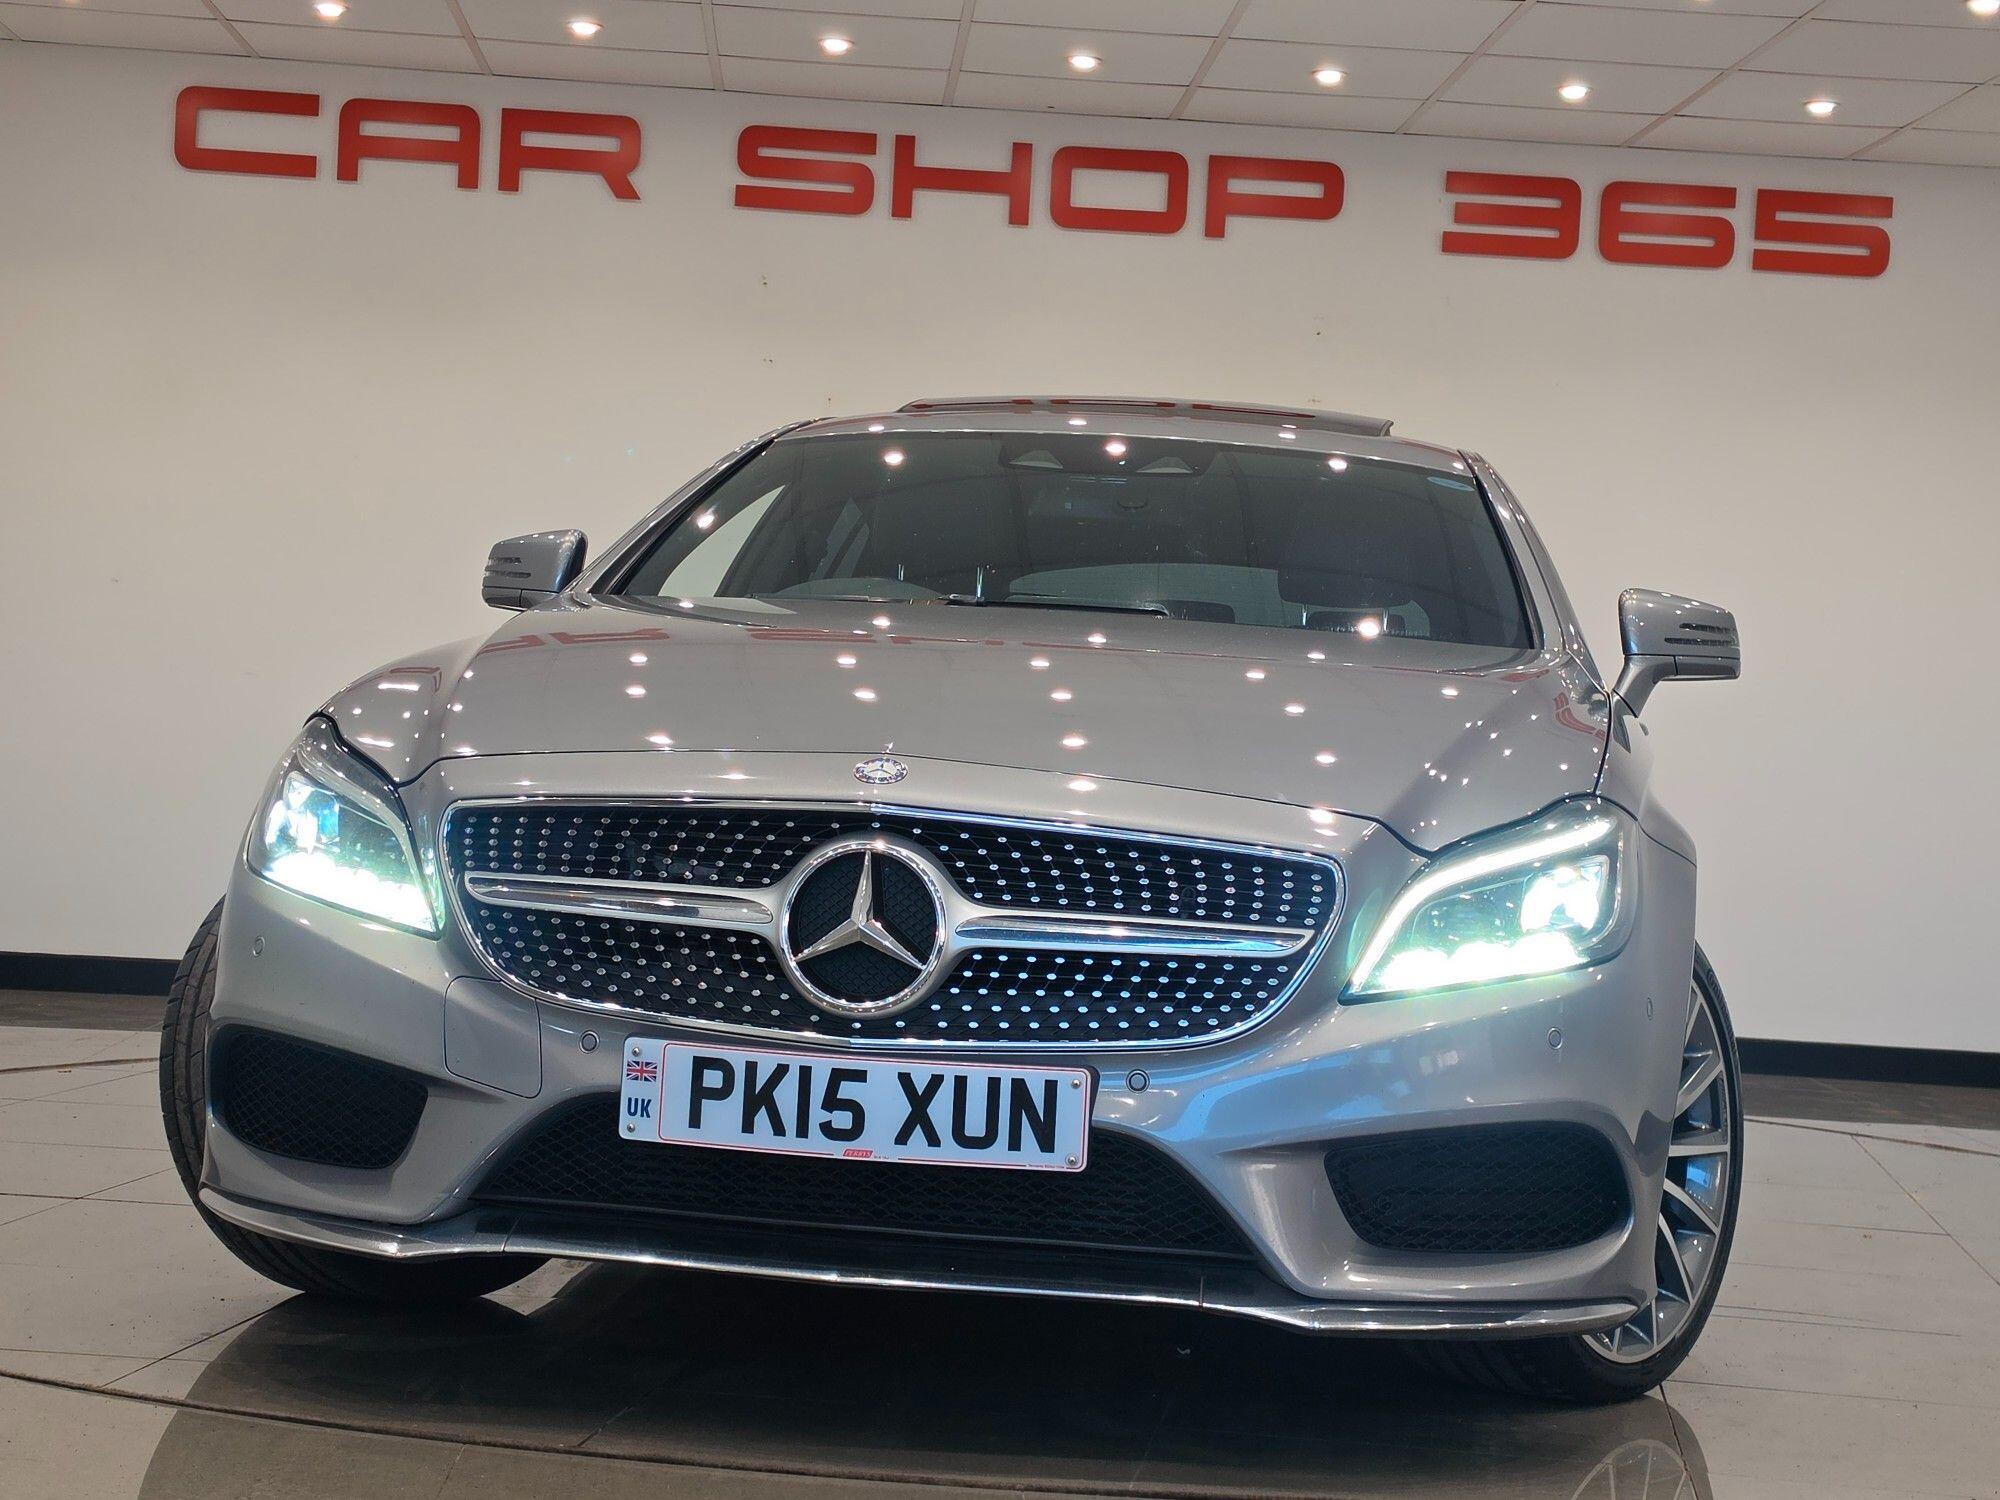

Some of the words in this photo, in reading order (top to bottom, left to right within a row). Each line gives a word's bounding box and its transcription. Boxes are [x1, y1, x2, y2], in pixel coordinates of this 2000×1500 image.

[175, 86, 642, 200] CAR
[735, 125, 1345, 237] SHOP
[1442, 172, 1894, 277] 365
[627, 1096, 651, 1119] UK
[688, 1055, 868, 1142] PK15
[894, 1071, 1057, 1154] XUN
